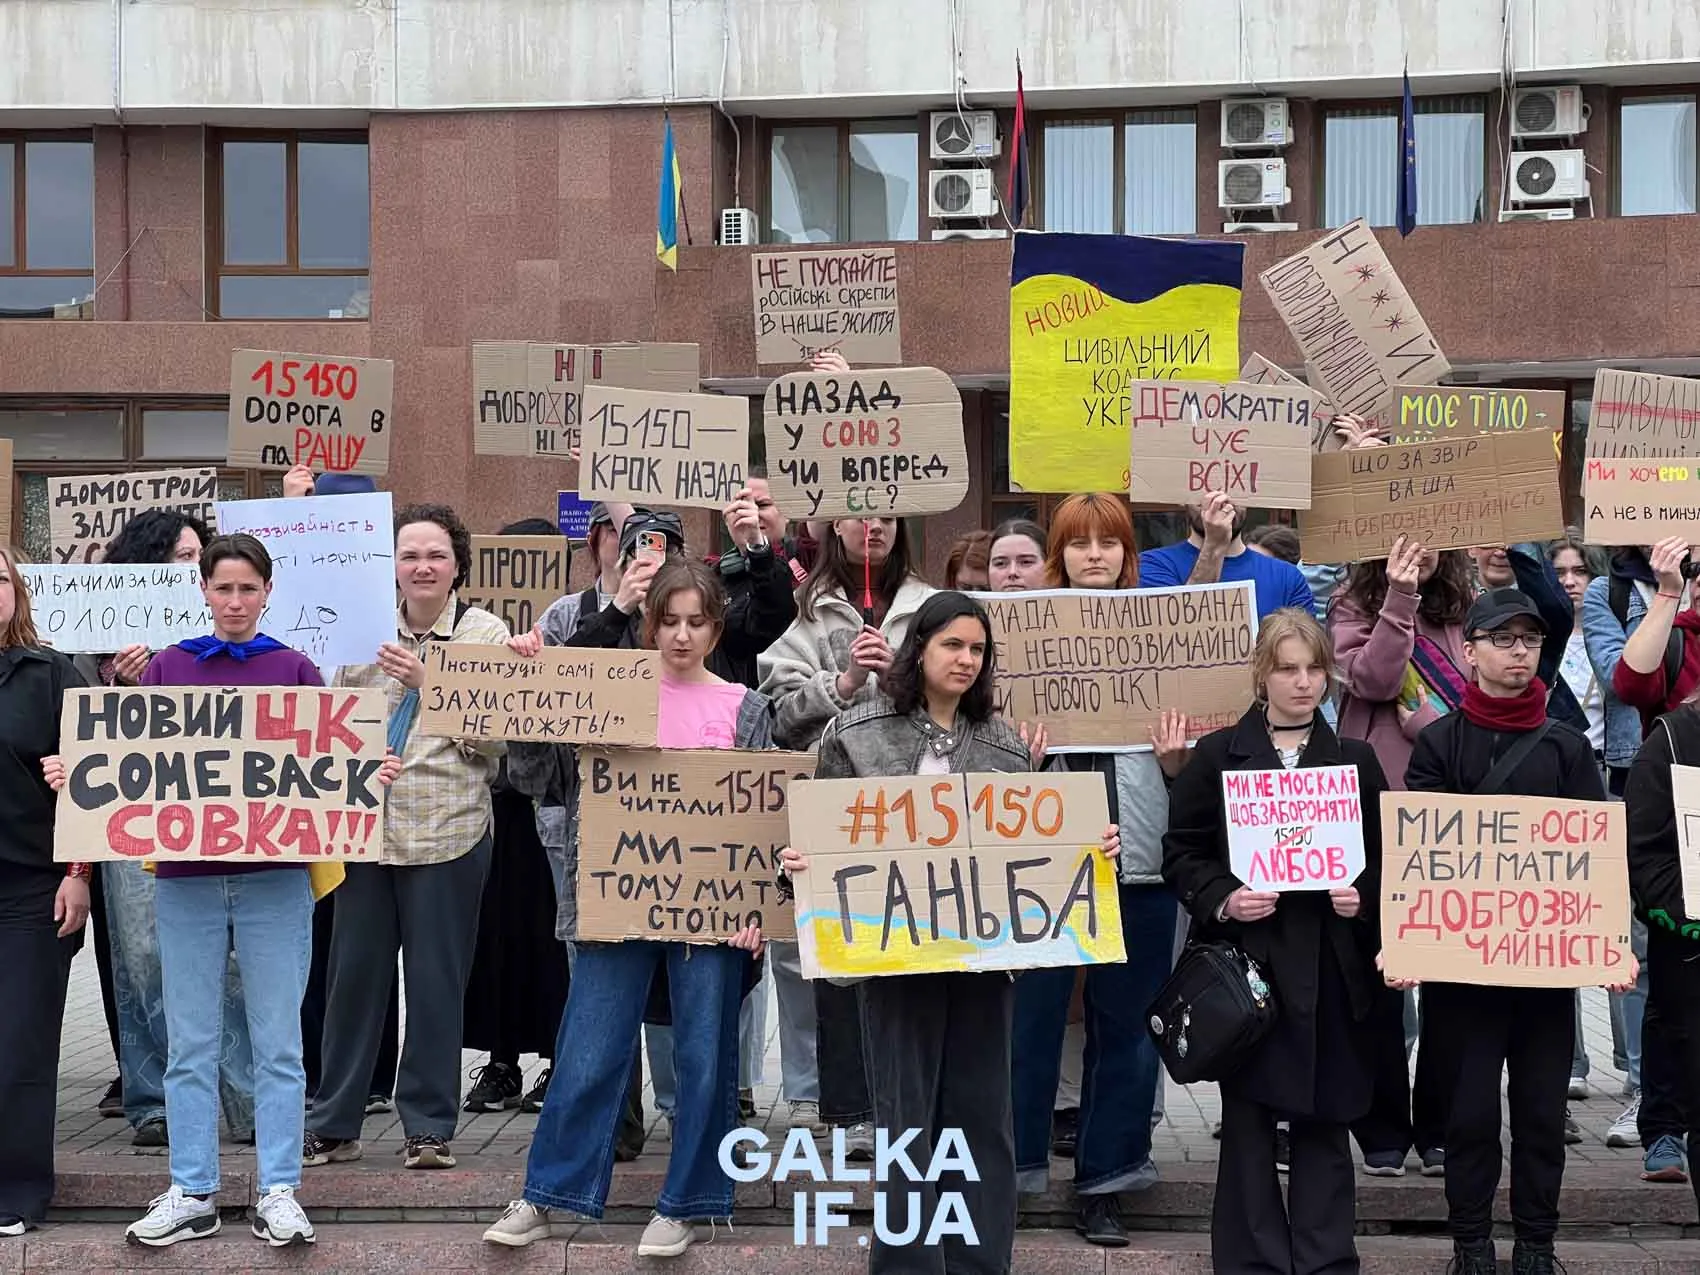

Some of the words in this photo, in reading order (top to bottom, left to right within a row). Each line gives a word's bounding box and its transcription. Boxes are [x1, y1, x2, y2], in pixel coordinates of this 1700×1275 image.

[757, 258, 792, 289] НЕ
[800, 252, 897, 286] ПУСКАЙТЕ
[760, 313, 776, 336] В
[782, 310, 839, 335] НАШЕ
[841, 309, 895, 336] ЖИТТЯ
[1025, 282, 1111, 338] НОВИЙ
[1064, 328, 1210, 365] ЦИВІЛЬНИЙ
[251, 360, 357, 399] 15150
[775, 378, 900, 417] НАЗАД
[245, 397, 342, 427] ДОРОГА
[371, 409, 384, 433] В
[1133, 386, 1310, 428] ДЕМОКРАТІЯ
[1401, 393, 1460, 428] МОЄ
[1469, 392, 1528, 430] ТІЛО
[536, 430, 555, 450] НІ
[784, 423, 803, 451] У
[823, 417, 901, 448] СОЮЗ
[1192, 428, 1250, 455] ЧУЄ
[779, 457, 819, 486] ЧИ
[842, 453, 948, 482] ВПЕРЕД
[1398, 450, 1424, 471] ЗА
[1430, 440, 1478, 464] ЗВІР
[55, 470, 216, 507] ДОМОСТРОЙ
[591, 452, 662, 494] КРОК
[675, 461, 744, 501] НАЗАД
[1189, 461, 1259, 493] ВСІХ!
[1389, 475, 1455, 502] ВАША
[1630, 466, 1688, 482] хочемо
[806, 488, 823, 516] У
[1590, 505, 1604, 519] А
[53, 574, 123, 595] БАЧИЛИ
[129, 573, 147, 588] ЗА
[480, 547, 560, 590] ПРОТИ
[1080, 587, 1245, 629] НАЛАШТОВАНА
[1024, 623, 1251, 673] НЕДОБРОЗВИЧАЙНО
[607, 658, 654, 680] себе
[428, 685, 593, 713] ЗАХИСТИТИ
[1033, 675, 1100, 715] НОВОГО
[77, 687, 243, 741] НОВИЙ
[462, 713, 493, 736] НЕ
[69, 749, 231, 810] COME
[242, 751, 384, 808] BACK
[1227, 775, 1250, 799] МИ
[1252, 773, 1274, 798] НЕ
[1279, 769, 1357, 798] МОСКАЛІ
[106, 802, 377, 857] СОВКА!!!
[1274, 826, 1314, 847] 15150
[1398, 807, 1463, 846] МИ
[1477, 809, 1520, 845] НЕ
[612, 830, 682, 866] МИ
[721, 843, 788, 873] ТАК
[1250, 847, 1348, 883] ЛЮБОВ
[1402, 849, 1482, 882] АБИ
[1496, 850, 1589, 882] МАТИ
[590, 871, 682, 901] ТОМУ
[693, 878, 744, 902] МИ
[833, 852, 1097, 952] ГАНЬБА
[648, 904, 763, 934] СТОЇМО
[1392, 888, 1602, 941] "ДОБРОЗВИ-
[1465, 928, 1629, 968] ЧАЙНІСТЬ"
